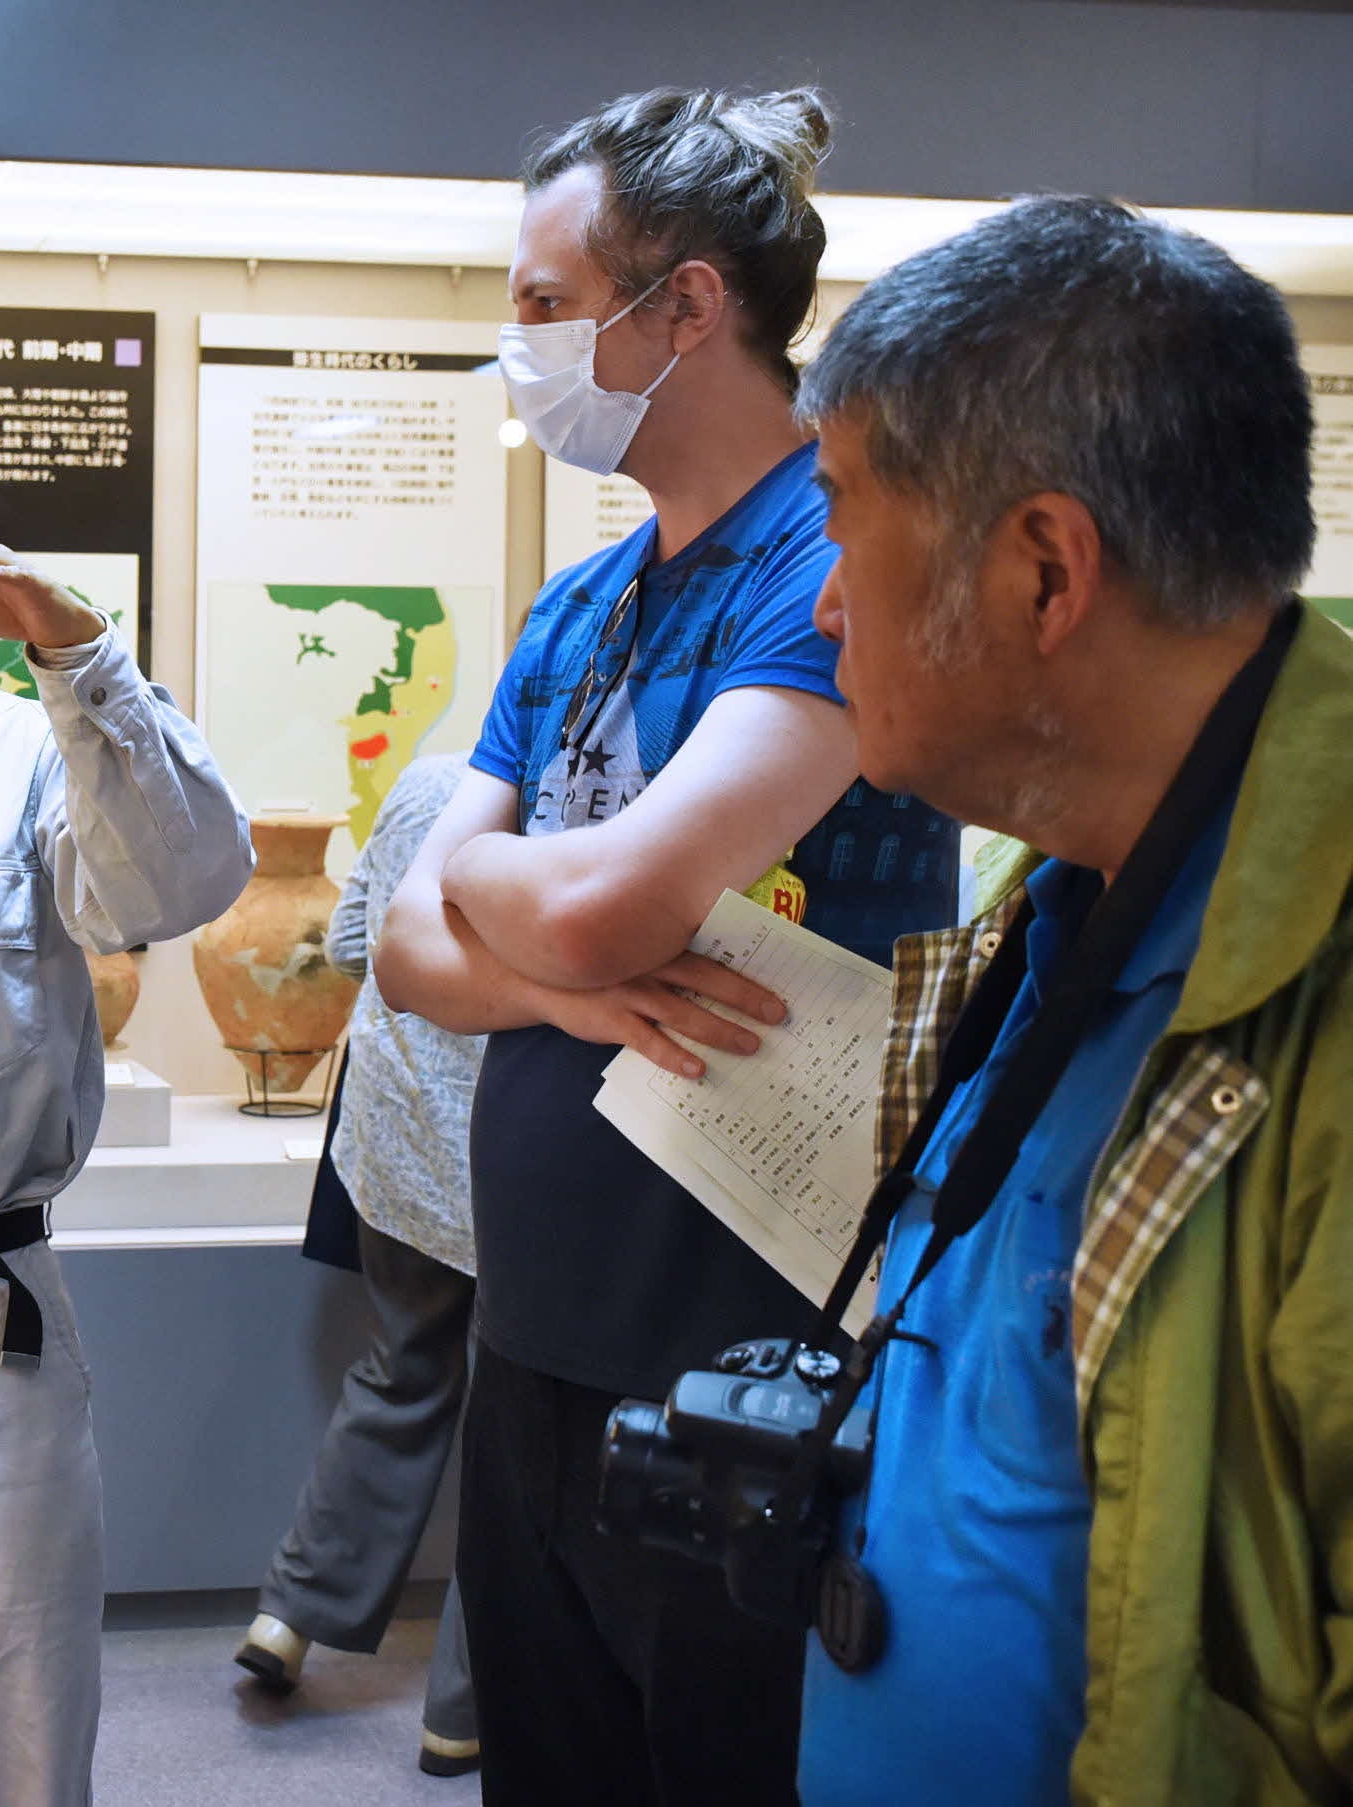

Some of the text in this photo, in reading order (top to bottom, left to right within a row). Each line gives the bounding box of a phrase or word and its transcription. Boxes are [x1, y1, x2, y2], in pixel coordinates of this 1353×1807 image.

[292, 350, 418, 370] 弥生時代のくらし
